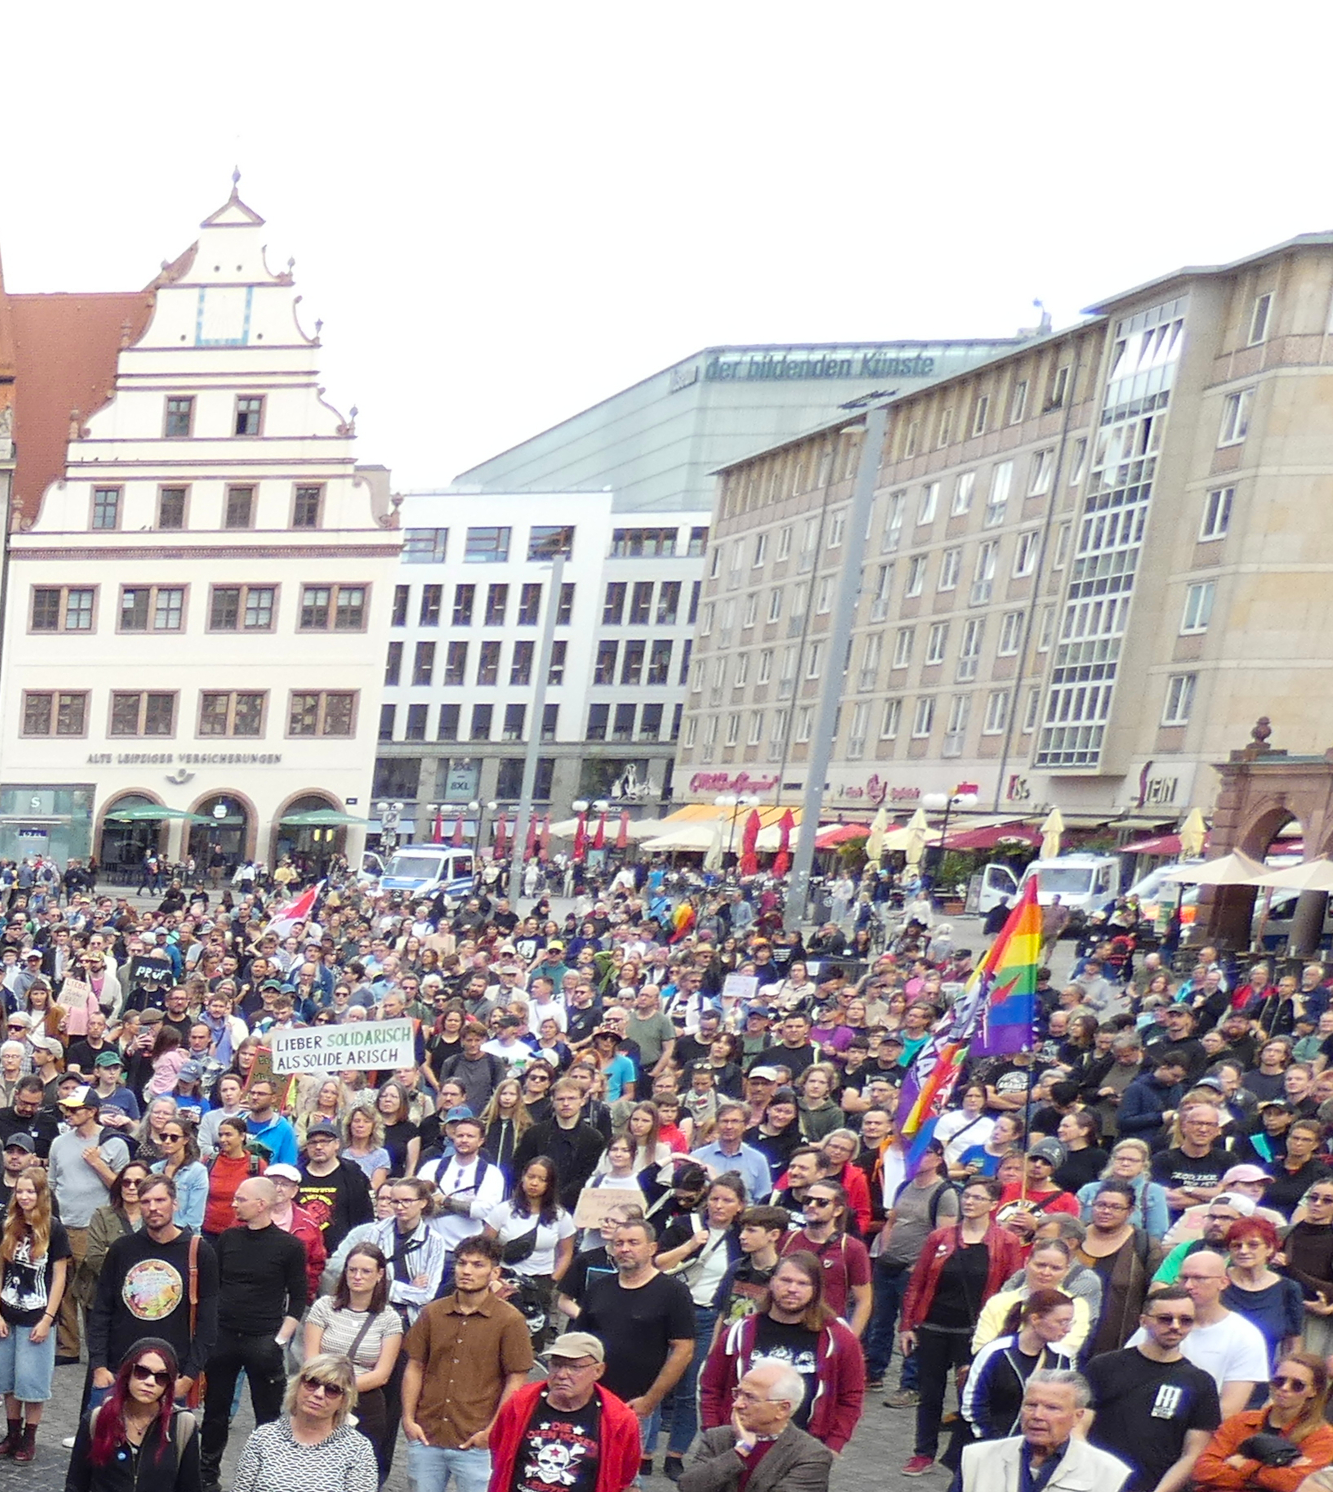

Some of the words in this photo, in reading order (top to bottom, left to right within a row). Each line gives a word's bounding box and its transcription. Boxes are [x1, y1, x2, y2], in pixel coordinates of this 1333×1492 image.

[704, 355, 742, 380] der
[746, 353, 853, 378] bildenden
[860, 351, 934, 377] Künste
[87, 753, 112, 765] ALTE
[117, 753, 173, 765] LEIPZIGER
[177, 753, 282, 765] VERSICHERUNGEN
[276, 1035, 323, 1052] LIEBER
[326, 1026, 411, 1048] SOLIDARISCH
[276, 1055, 300, 1071] ALS
[303, 1052, 343, 1068] SOLIDE
[346, 1048, 399, 1066] ARISCH
